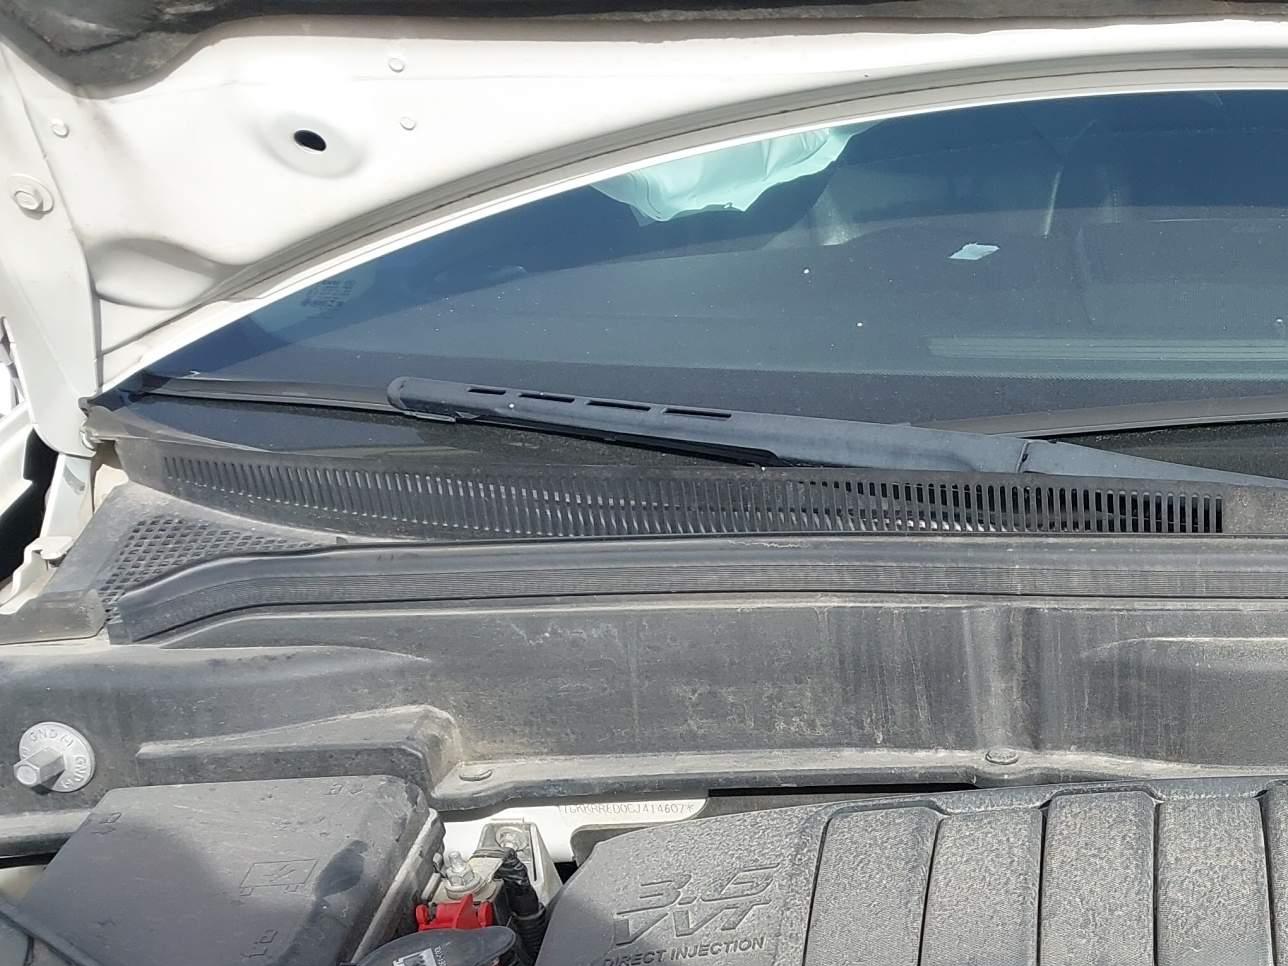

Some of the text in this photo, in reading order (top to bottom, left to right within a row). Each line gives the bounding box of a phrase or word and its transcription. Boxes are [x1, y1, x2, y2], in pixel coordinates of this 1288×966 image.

[30, 727, 58, 743] GND
[616, 862, 781, 916] 3.6
[614, 899, 774, 947] VVT
[670, 937, 765, 961] INJECTION
